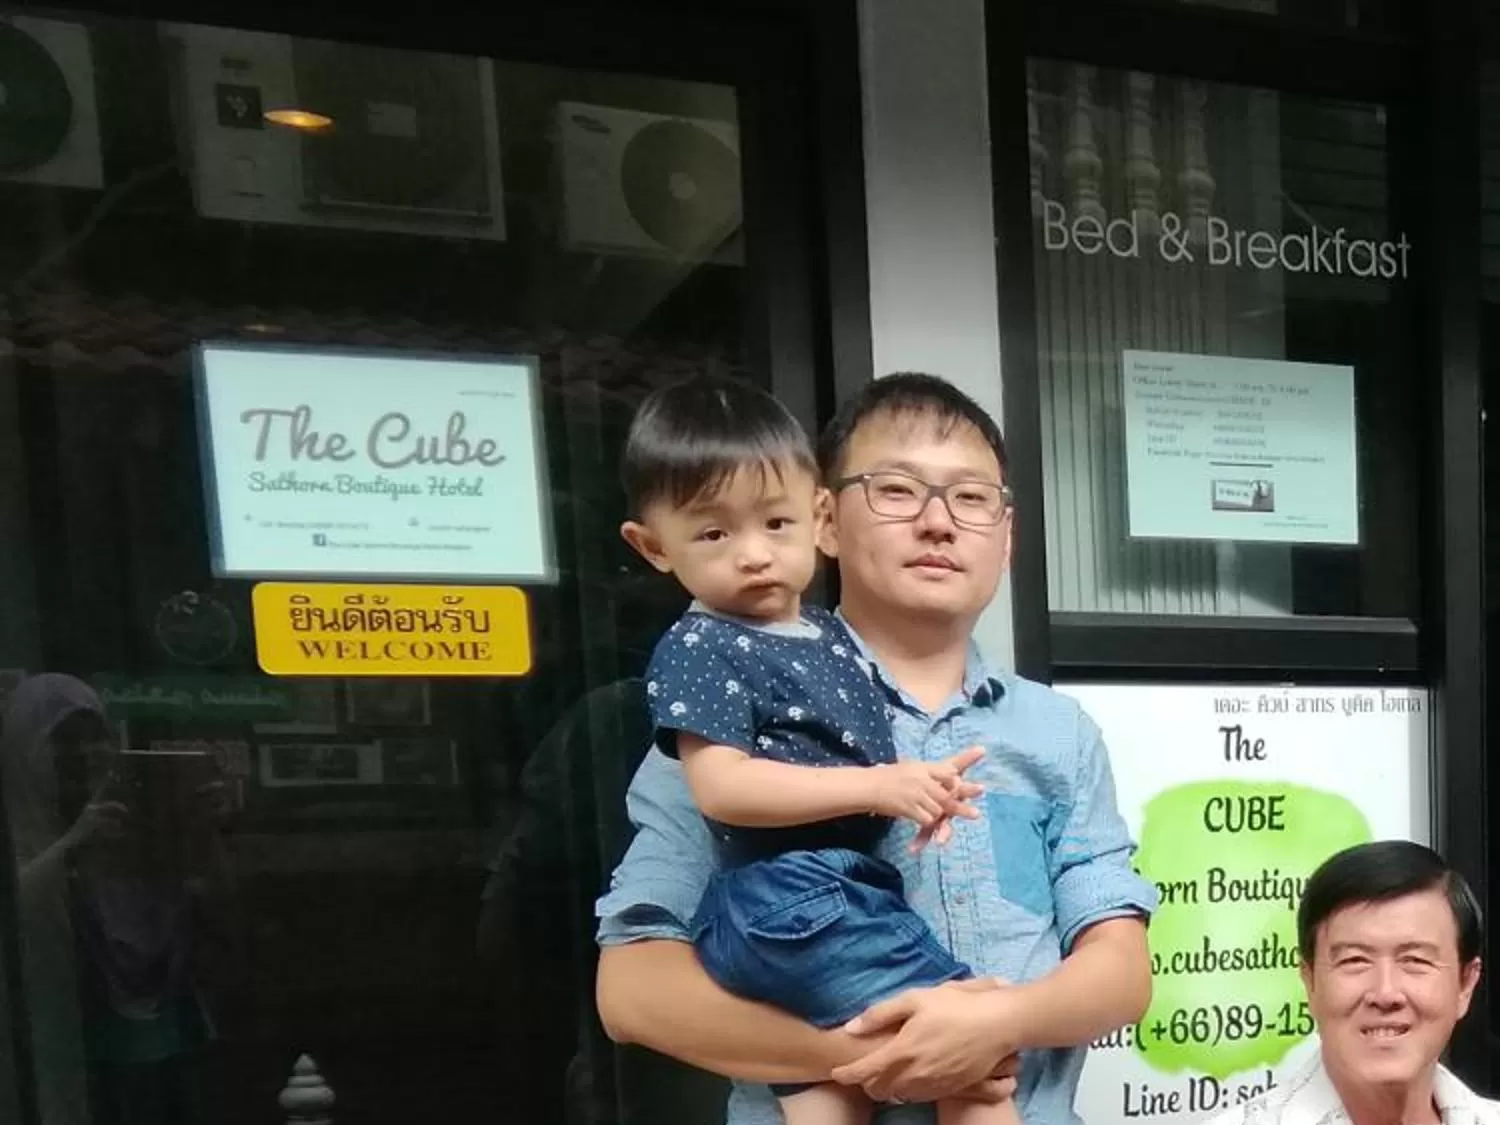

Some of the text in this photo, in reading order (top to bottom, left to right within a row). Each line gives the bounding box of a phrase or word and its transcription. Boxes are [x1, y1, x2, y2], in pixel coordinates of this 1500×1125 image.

[1043, 201, 1412, 279] Bed & Breakfast
[240, 404, 506, 469] The Cube
[248, 471, 485, 502] Sathorn Boutique Hotel
[289, 594, 490, 633] ยินดีต้อนรับ
[297, 639, 492, 661] WELCOME
[1218, 723, 1268, 763] The
[1203, 794, 1286, 834] CUBE
[1206, 866, 1310, 911] Boutiqu
[1123, 1082, 1182, 1118] Line
[1189, 1075, 1229, 1112] ID:
